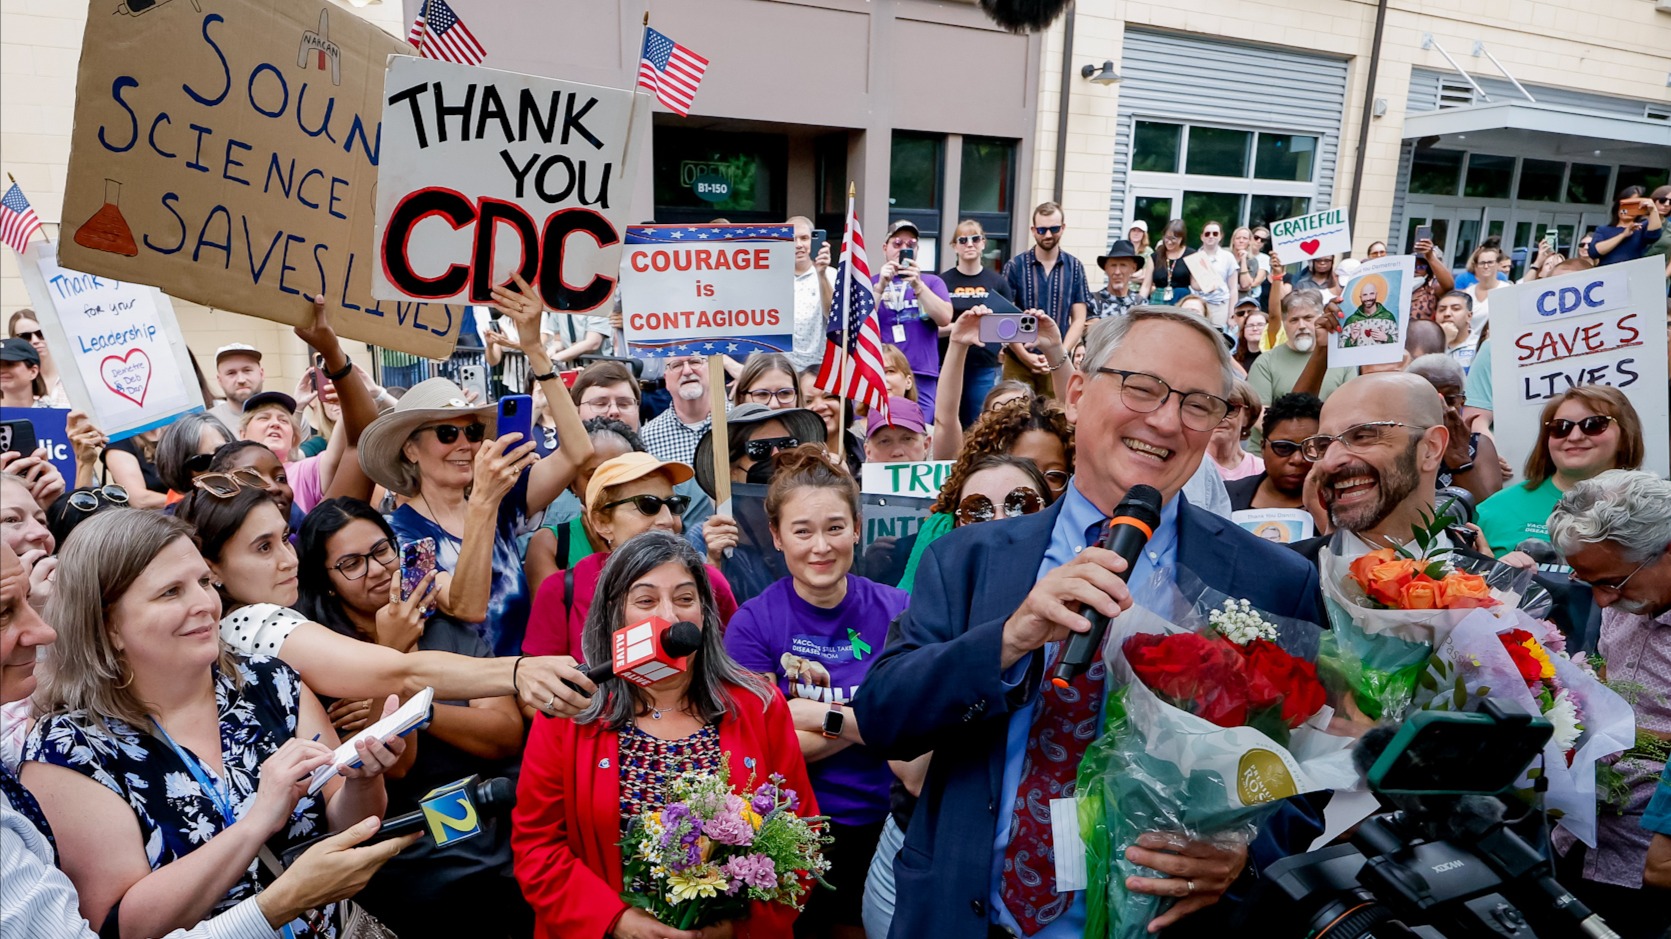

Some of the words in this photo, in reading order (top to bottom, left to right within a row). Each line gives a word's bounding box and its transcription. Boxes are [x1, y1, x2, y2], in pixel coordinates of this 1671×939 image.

[304, 35, 339, 58] NARCAN
[388, 81, 605, 150] THANK
[98, 76, 349, 220] SCIENCE
[499, 149, 612, 209] YOU
[697, 182, 728, 194] B1-150
[1273, 209, 1345, 237] GRATEFUL
[143, 192, 328, 300] SAVES
[381, 186, 620, 312] CDC
[630, 248, 770, 273] COURAGE
[696, 279, 715, 297] is
[1536, 280, 1605, 317] CDC
[629, 308, 780, 331] CONTAGIOUS
[78, 323, 157, 354] Leadership
[1524, 357, 1639, 401] LIVES
[615, 633, 625, 668] ALIVE
[422, 798, 477, 847] 2
